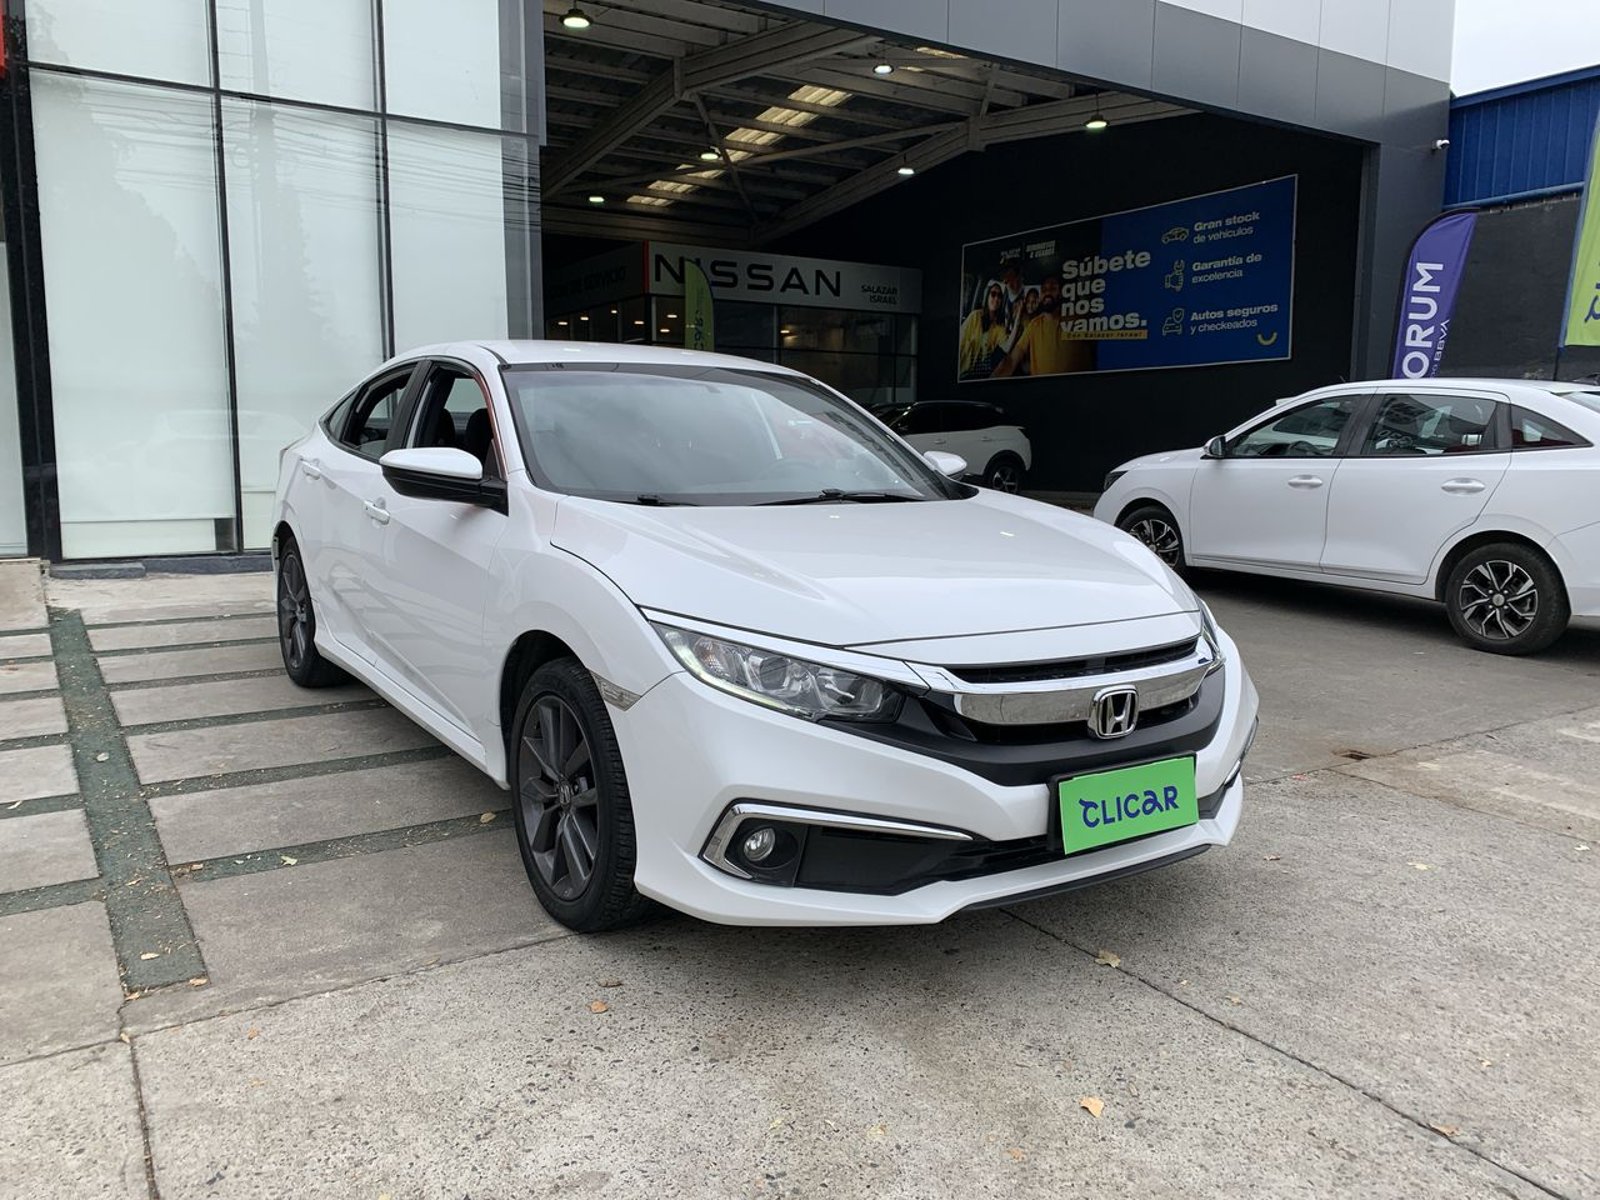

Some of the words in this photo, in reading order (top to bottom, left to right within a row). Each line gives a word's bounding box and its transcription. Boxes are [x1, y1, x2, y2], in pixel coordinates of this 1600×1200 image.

[1194, 220, 1222, 232] Gran
[1225, 211, 1260, 226] stock
[1193, 233, 1206, 244] de
[1062, 249, 1151, 280] Súbete
[1246, 252, 1263, 263] de
[655, 254, 841, 297] NSSAN
[1192, 268, 1243, 283] excelencia
[1061, 278, 1106, 301] que
[1061, 297, 1105, 317] nos
[1190, 309, 1225, 322] Autos
[1227, 304, 1278, 318] seguros
[1060, 312, 1147, 333] vamos.
[1198, 318, 1258, 333] checkeados
[1434, 319, 1450, 361] BBVA
